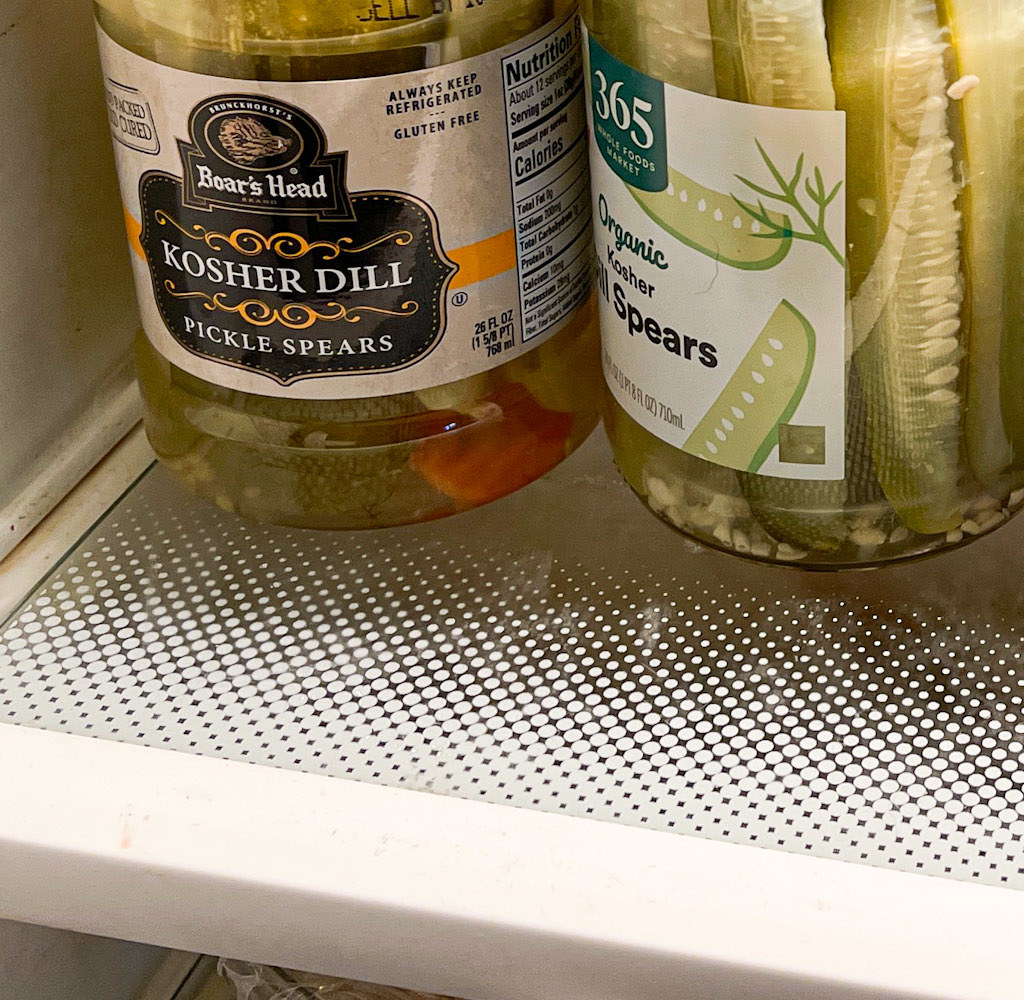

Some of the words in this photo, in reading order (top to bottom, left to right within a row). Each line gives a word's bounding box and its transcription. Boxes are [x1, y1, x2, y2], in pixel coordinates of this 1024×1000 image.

[506, 30, 572, 87] Nutrition
[386, 85, 482, 115] REFRIGERATED
[389, 82, 442, 102] ALWAYS
[448, 73, 477, 90] KEEP
[509, 85, 534, 107] About
[535, 77, 544, 97] 12
[114, 95, 146, 120] PACKED
[208, 101, 293, 121] BRUNCKHORST'S
[511, 101, 540, 126] Serving
[540, 92, 553, 110] size
[595, 70, 653, 149] 365
[120, 115, 153, 141] CURED
[394, 120, 445, 139] GLUTEN
[450, 110, 480, 128] FREE
[513, 133, 539, 154] Amount
[539, 123, 549, 142] per
[515, 136, 564, 178] Calories
[606, 146, 640, 176] MARKET
[623, 146, 656, 172] FOODS
[196, 165, 263, 196] Boar's
[265, 174, 328, 199] Head
[517, 198, 535, 216] Total
[535, 191, 546, 208] Fat
[519, 215, 544, 234] Sodium
[599, 193, 669, 270] Organic
[520, 234, 537, 252] Total
[160, 239, 305, 294] KOSHER
[315, 261, 413, 293] DILL
[521, 250, 545, 270] Protein
[607, 246, 655, 298] Kosher
[522, 270, 550, 292] Calcium
[524, 284, 557, 310] Potassium
[183, 315, 272, 354] PICKLE
[283, 334, 394, 357] SPEARS
[472, 336, 480, 351] (1
[483, 330, 497, 345] 5/8
[500, 323, 515, 346] PT)
[474, 320, 486, 335] 26
[488, 316, 499, 330] FL
[501, 309, 514, 324] OZ
[613, 281, 718, 368] Spears
[658, 401, 685, 432] 710mL
